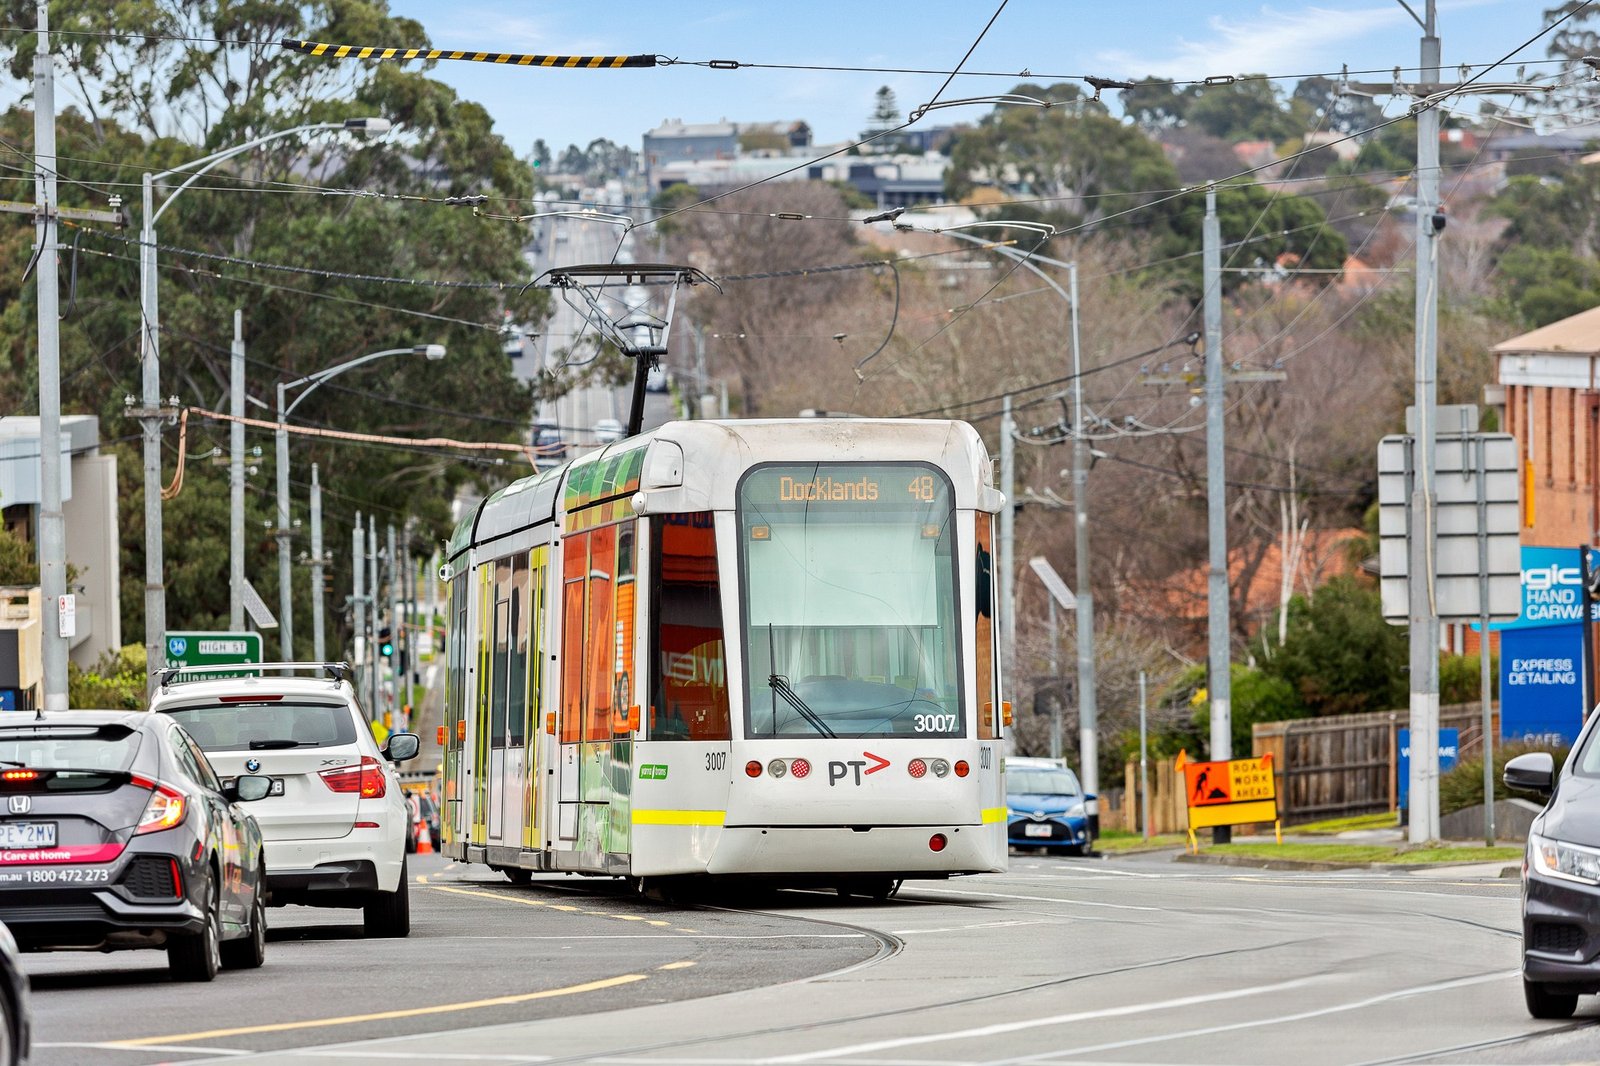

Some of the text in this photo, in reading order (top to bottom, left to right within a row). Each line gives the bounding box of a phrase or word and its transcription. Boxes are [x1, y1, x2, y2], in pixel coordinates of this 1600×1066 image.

[779, 476, 933, 501] Docklands 48
[1521, 564, 1582, 590] gic
[1526, 589, 1575, 604] HAND
[200, 643, 226, 651] HIGH
[232, 643, 245, 651] ST
[1512, 658, 1573, 672] EXPRESS
[1508, 671, 1576, 685] DETAILING
[914, 714, 956, 732] 3007
[1523, 733, 1561, 748] CAFE
[320, 759, 348, 767] X3
[705, 752, 726, 771] 3007
[1232, 763, 1263, 772] ROA
[1235, 775, 1267, 785] WORK
[1236, 786, 1269, 798] AHEAD
[3, 850, 27, 861] Care
[28, 850, 40, 860] at
[41, 850, 71, 860] home
[26, 870, 56, 883] 1800
[59, 869, 82, 882] 472
[85, 869, 109, 882] 273
